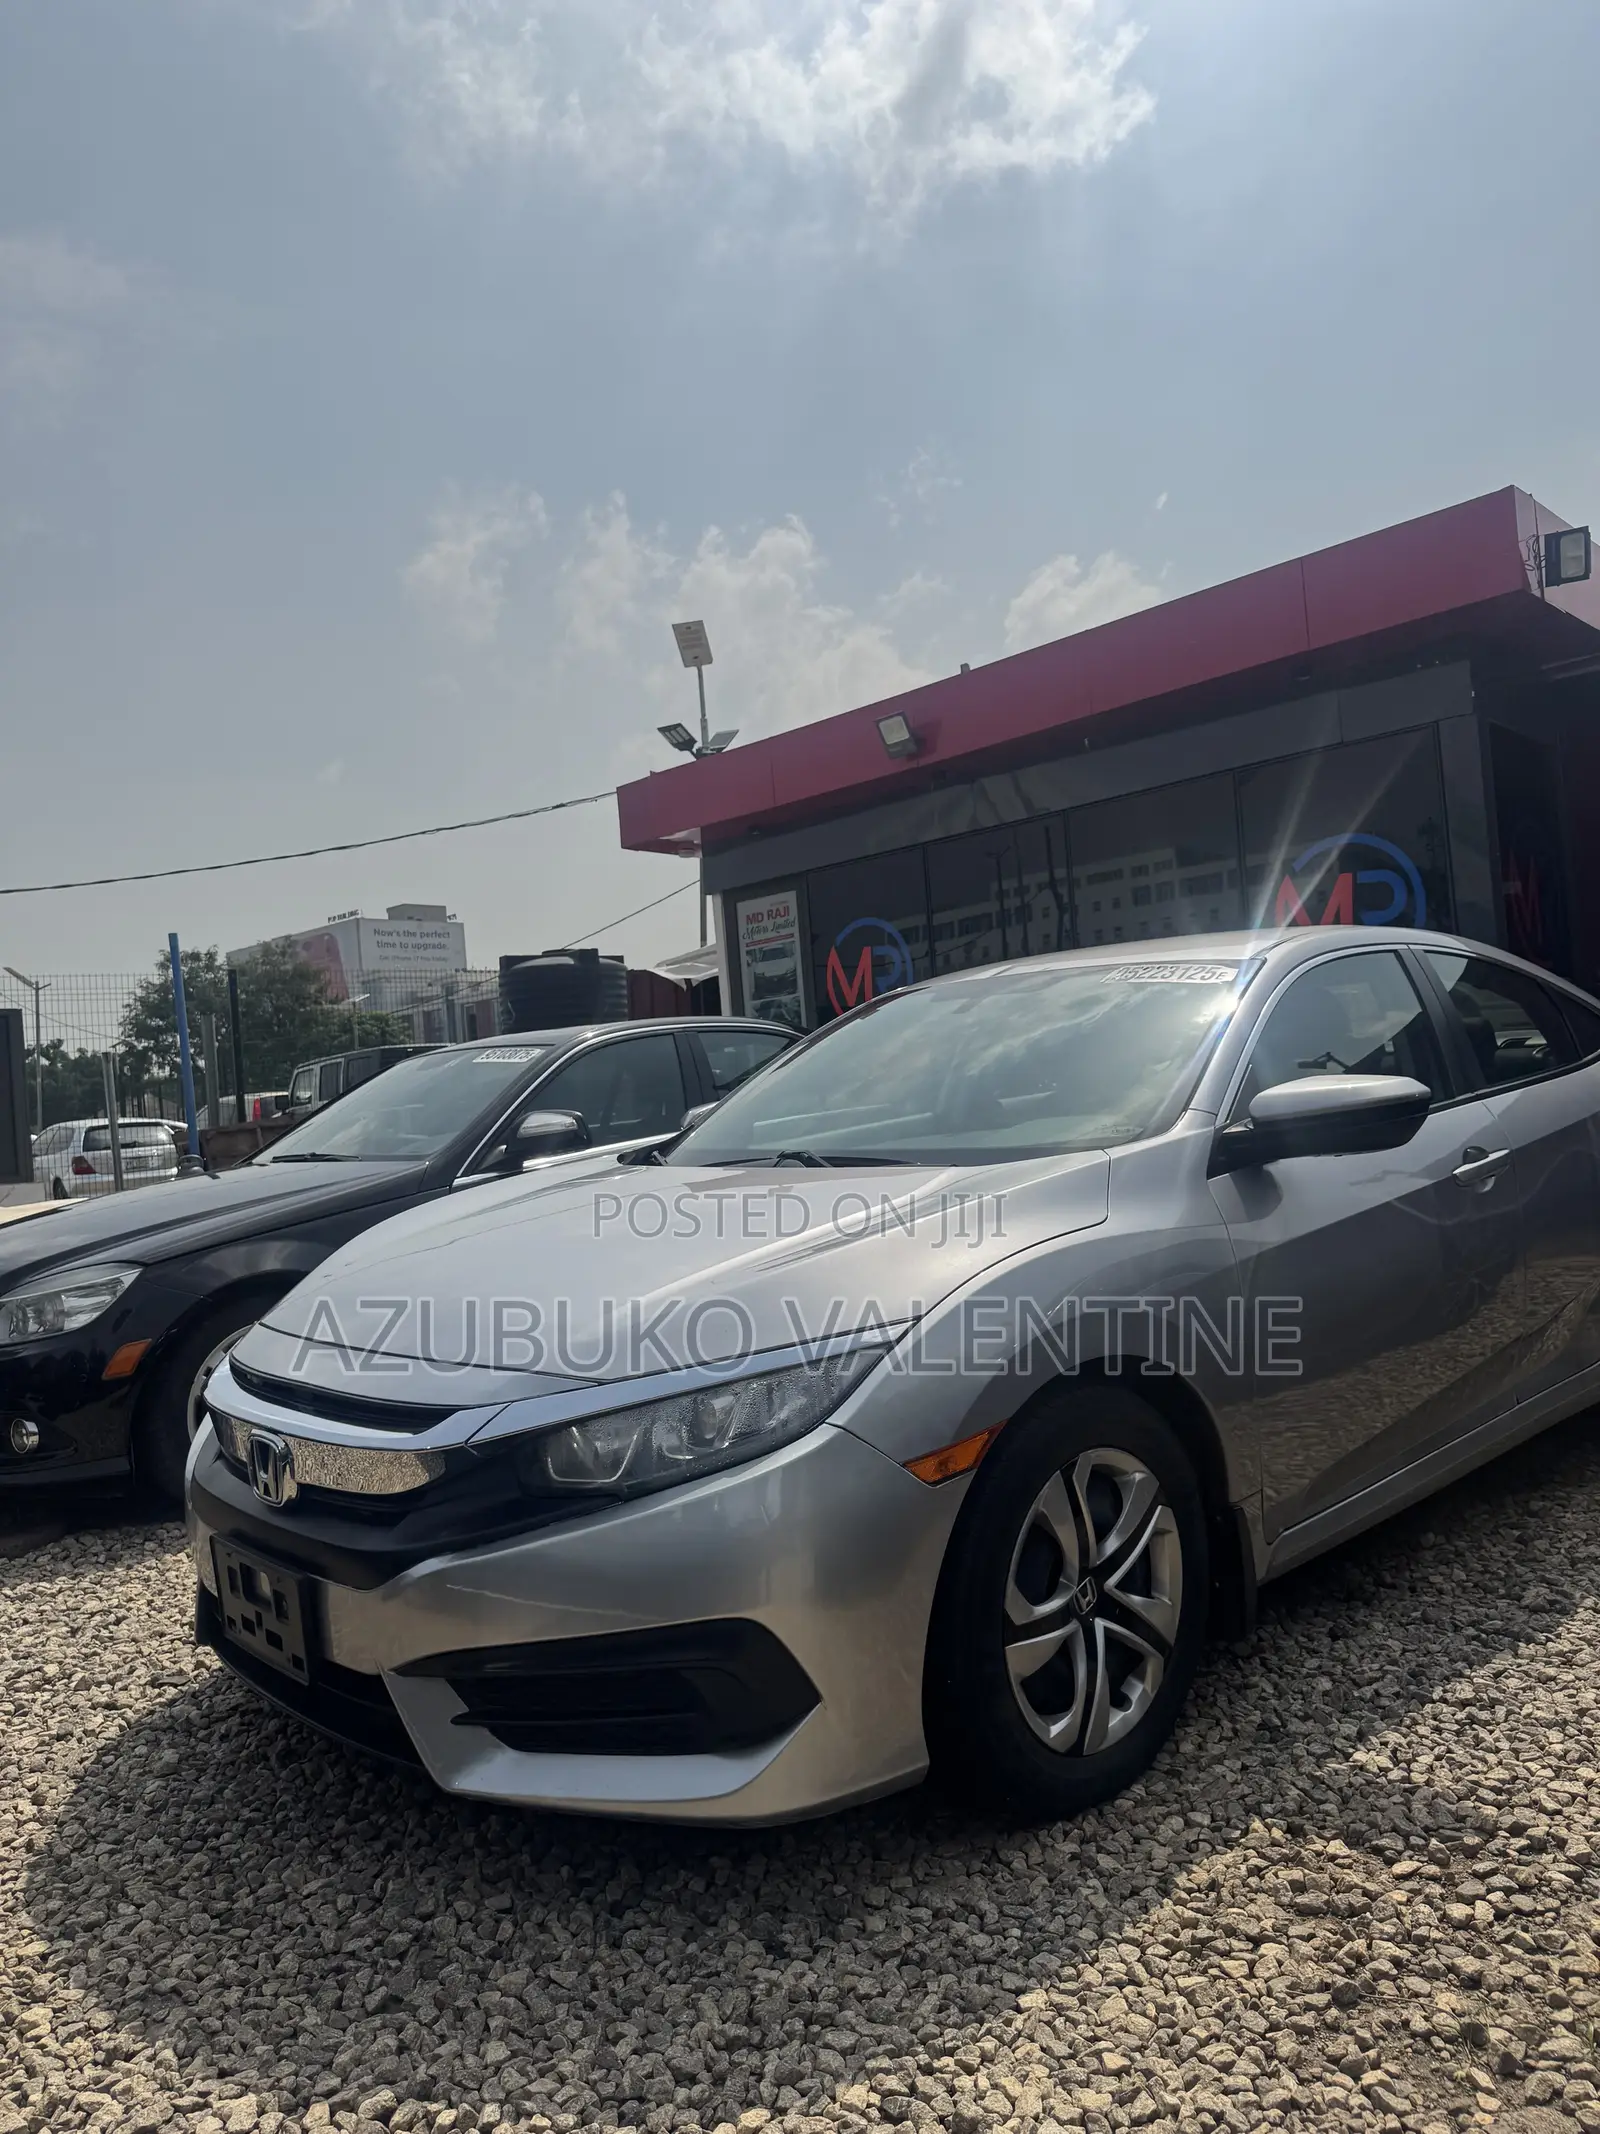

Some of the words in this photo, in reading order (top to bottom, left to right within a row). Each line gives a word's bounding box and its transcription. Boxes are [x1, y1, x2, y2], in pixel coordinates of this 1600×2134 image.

[745, 912, 764, 925] MD
[767, 905, 790, 921] RAJI
[373, 928, 401, 937] Now's
[403, 929, 417, 938] the
[420, 930, 450, 939] perfect
[376, 940, 397, 949] time
[400, 941, 409, 949] to
